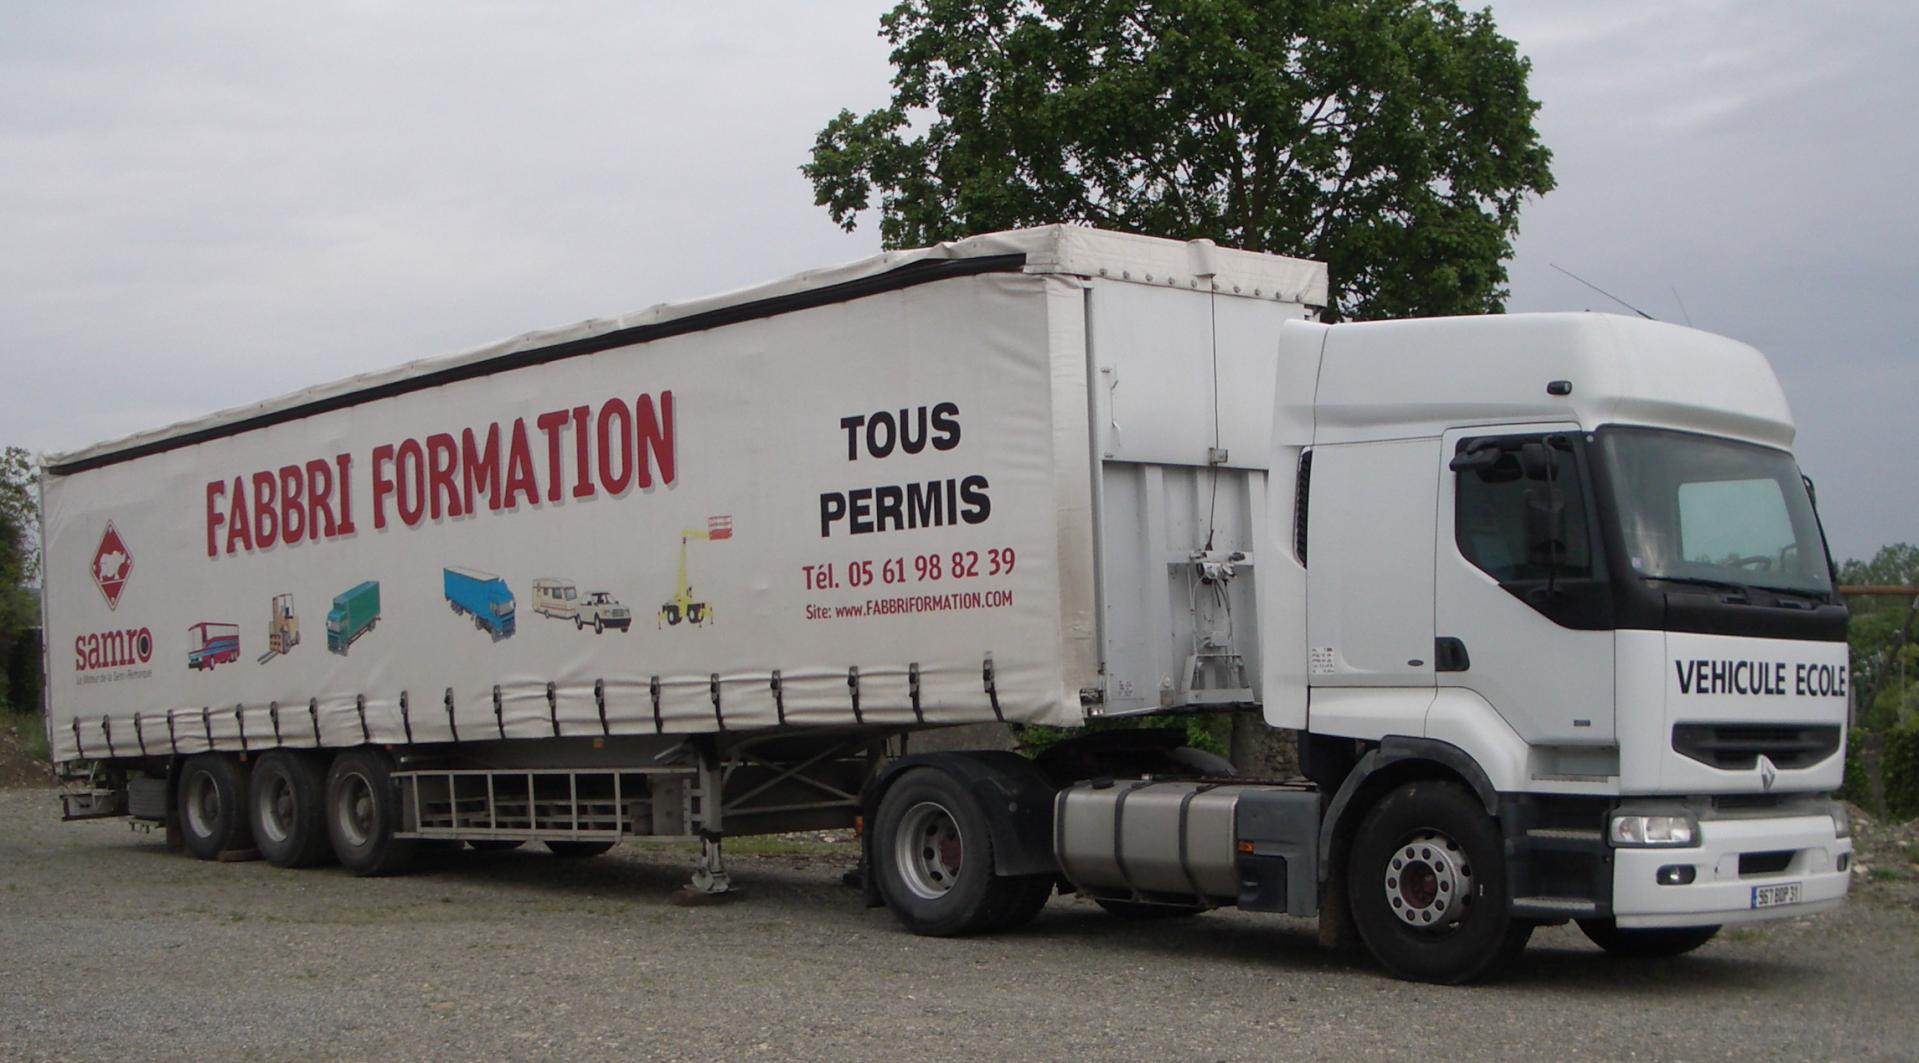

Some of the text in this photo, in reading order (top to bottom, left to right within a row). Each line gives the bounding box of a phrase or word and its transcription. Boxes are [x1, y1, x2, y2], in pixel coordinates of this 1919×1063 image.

[840, 402, 961, 462] TOUS
[206, 390, 676, 559] FABBRI FORMATION
[820, 475, 991, 538] PERMIS
[802, 547, 1016, 590] Tél. 05 61 98 82 39
[805, 604, 832, 620] Site:
[75, 626, 153, 671] samro
[1675, 659, 1846, 697] VEHICULE ECOLE
